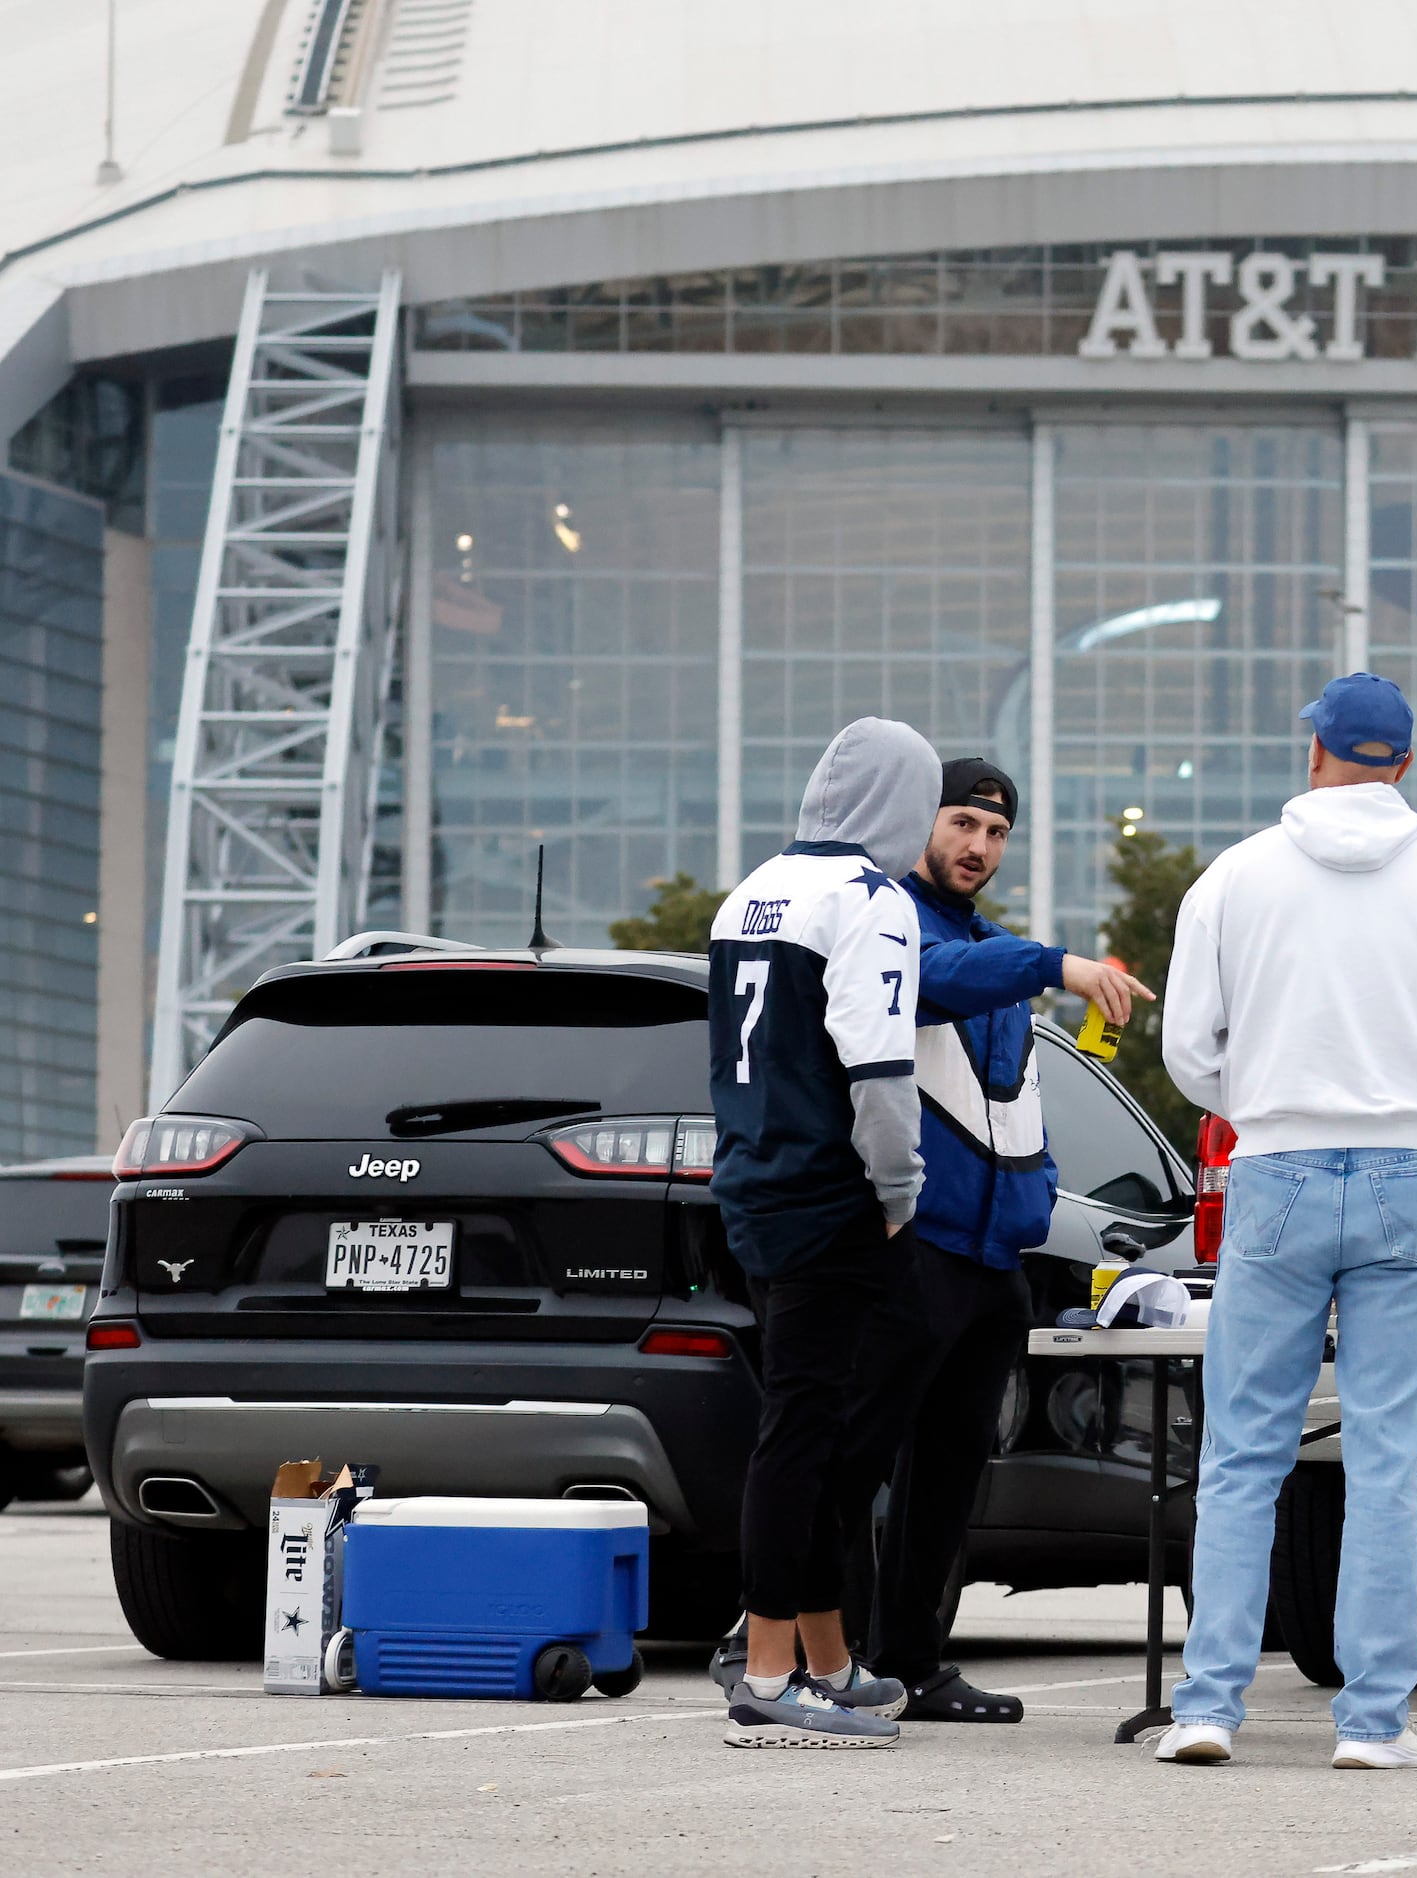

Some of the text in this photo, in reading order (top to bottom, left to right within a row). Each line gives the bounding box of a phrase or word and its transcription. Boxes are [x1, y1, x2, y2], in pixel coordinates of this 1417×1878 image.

[1078, 250, 1384, 359] AT&T
[741, 899, 791, 935] DIGGS
[880, 970, 903, 1016] 7
[734, 960, 770, 1084] 7
[348, 1153, 421, 1183] Jeep
[369, 1224, 418, 1238] TEXAS
[566, 1268, 648, 1280] LIMITED
[272, 1510, 280, 1522] 24
[281, 1532, 308, 1582] Lite
